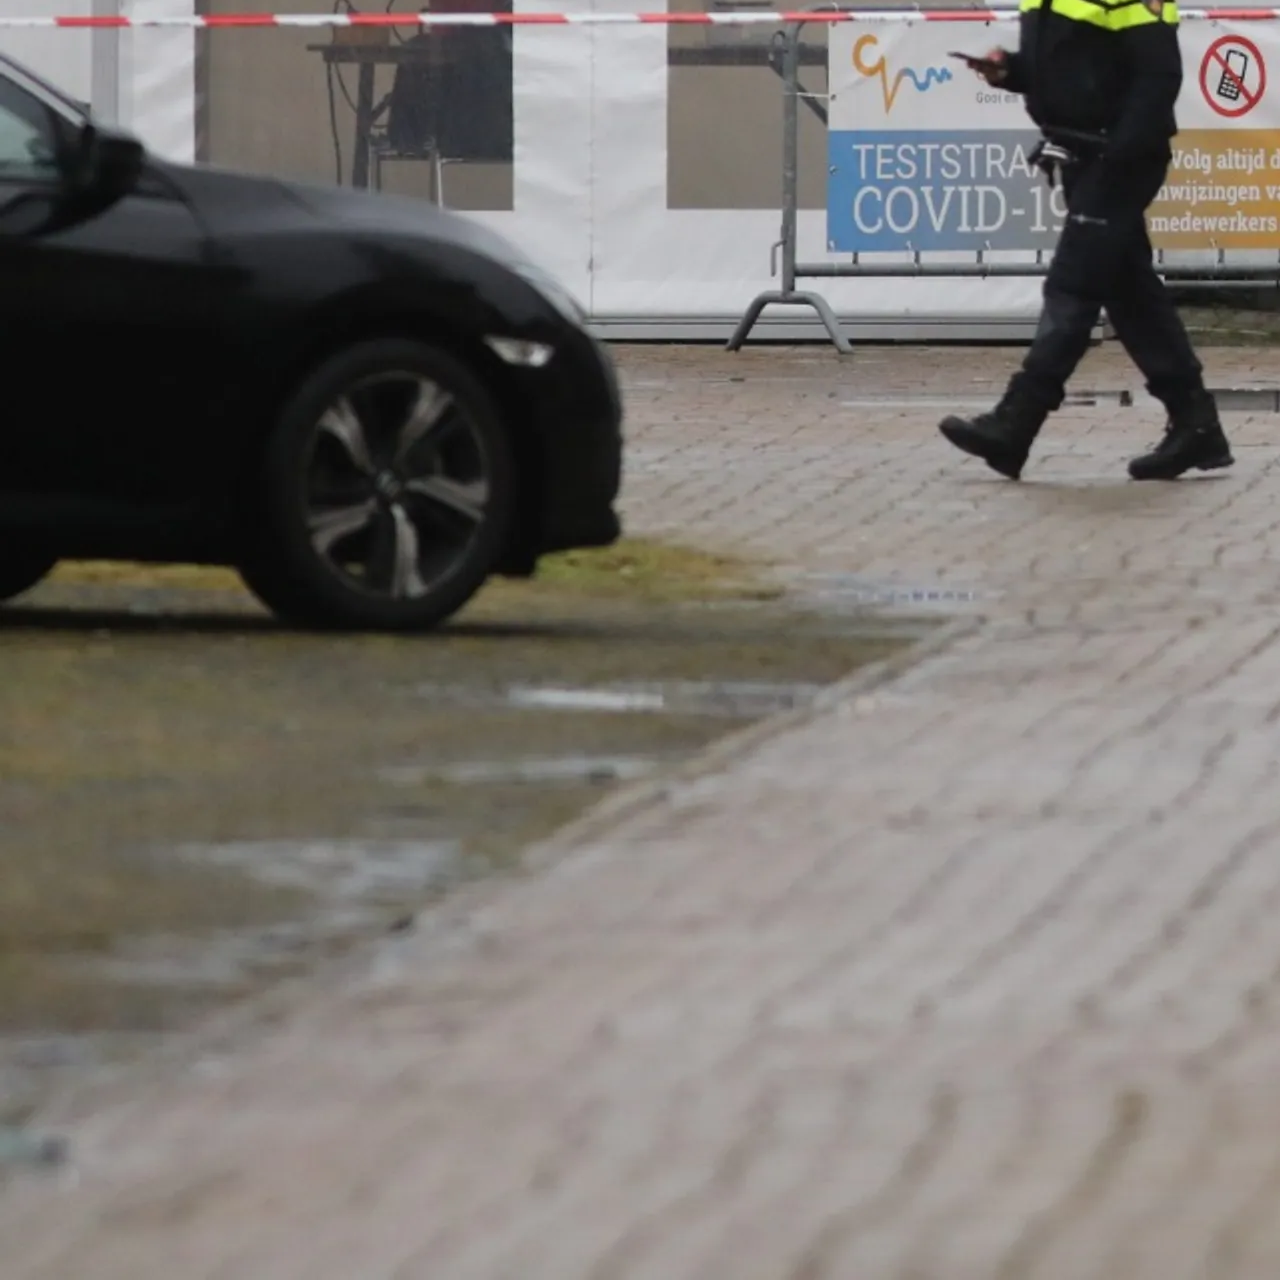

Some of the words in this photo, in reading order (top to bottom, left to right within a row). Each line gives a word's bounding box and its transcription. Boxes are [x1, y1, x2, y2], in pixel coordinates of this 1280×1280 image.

[976, 91, 1001, 103] Gooi
[852, 144, 1039, 179] TESTSTRA
[1171, 148, 1211, 174] Volg
[1216, 148, 1265, 174] altijd
[1153, 180, 1260, 206] nwijzingen
[853, 185, 1069, 233] COVID-19
[1151, 210, 1277, 232] medewerkers
